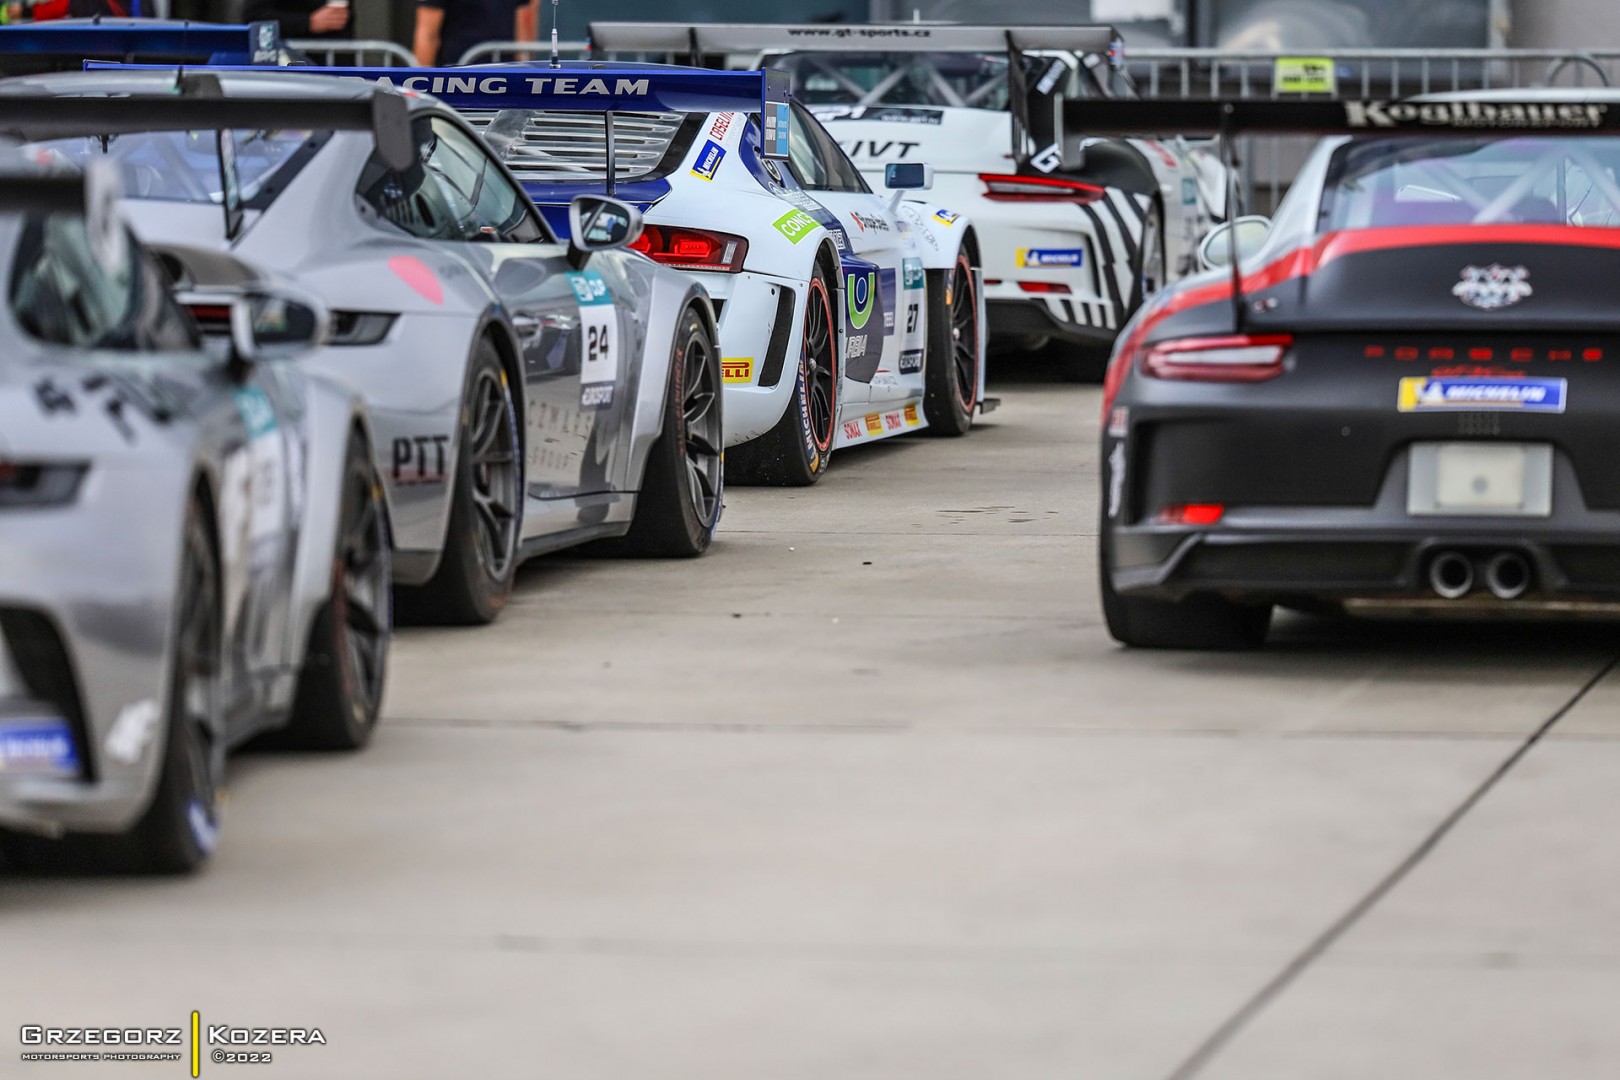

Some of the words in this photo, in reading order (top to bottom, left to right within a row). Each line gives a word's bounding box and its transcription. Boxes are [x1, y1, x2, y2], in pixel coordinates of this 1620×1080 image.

[339, 76, 508, 95] ACING
[525, 78, 650, 96] TEAM
[906, 303, 919, 334] 27
[588, 324, 610, 362] 24
[392, 434, 449, 478] PTT
